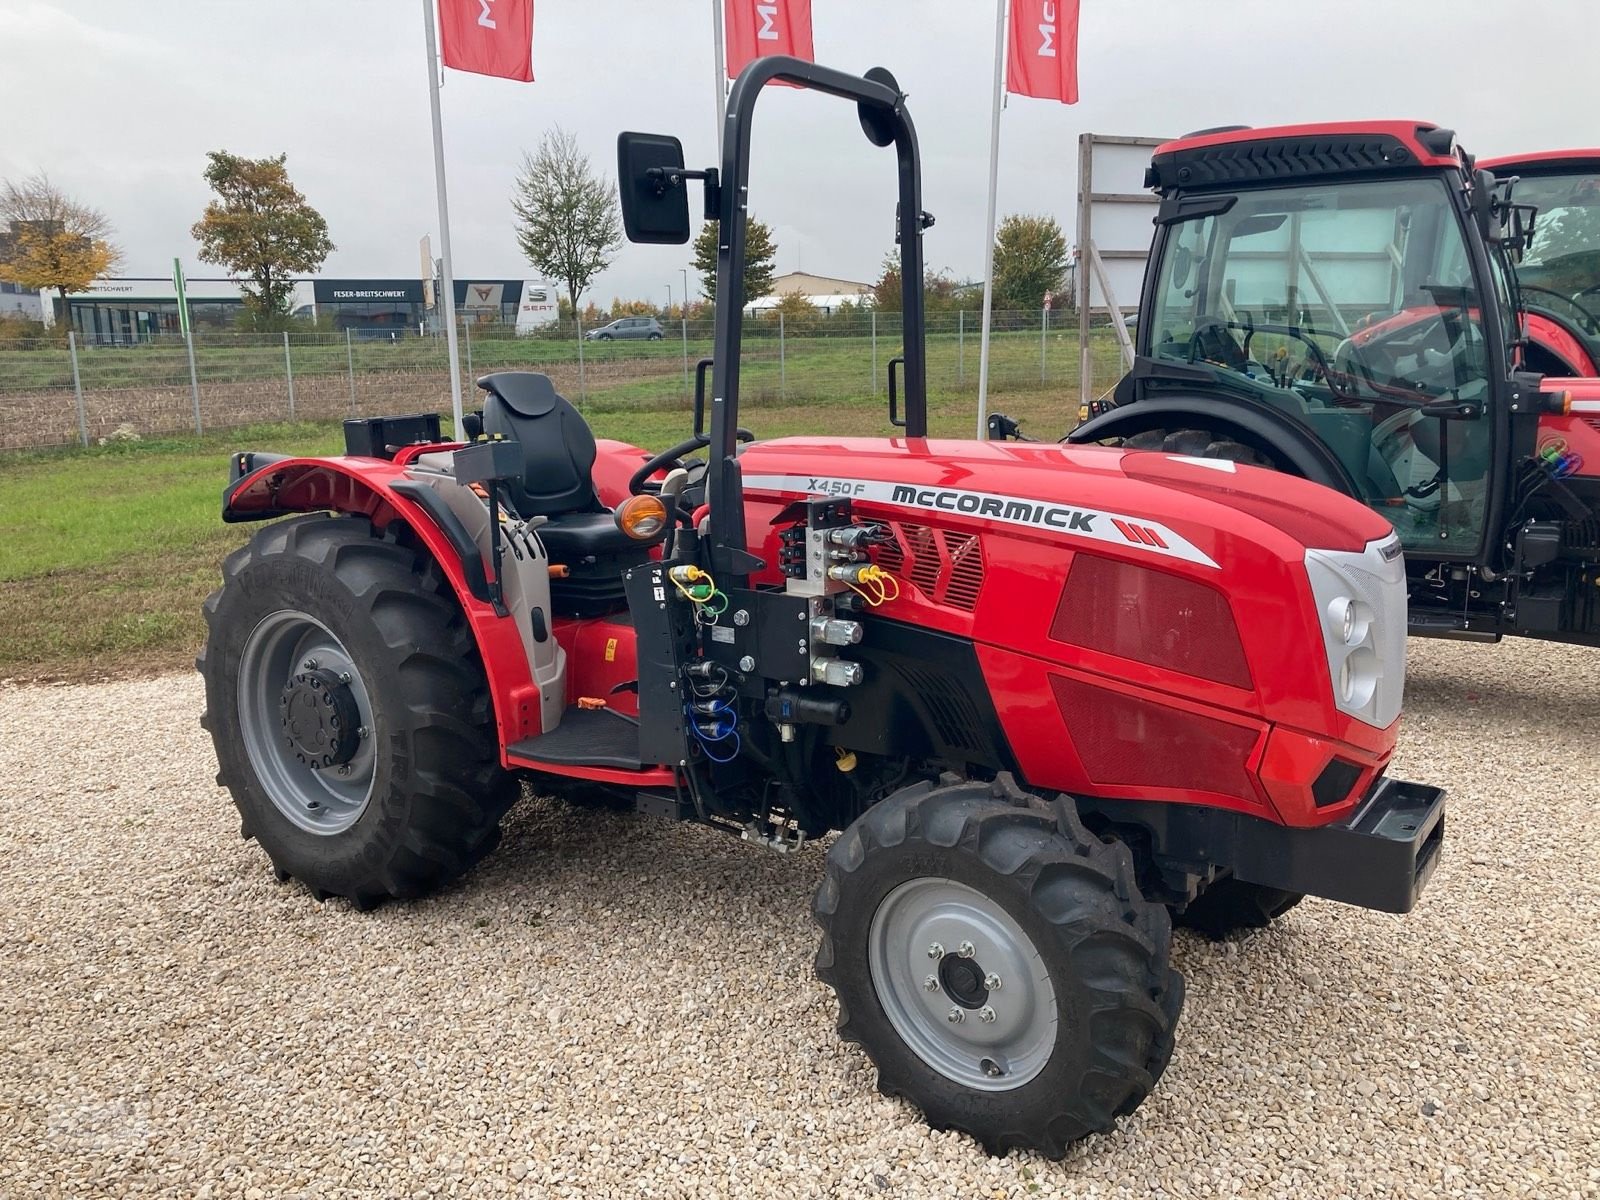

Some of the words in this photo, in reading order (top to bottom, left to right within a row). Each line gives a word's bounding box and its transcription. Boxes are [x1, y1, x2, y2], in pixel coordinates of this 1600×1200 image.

[333, 290, 406, 298] FESER-BREITSCHWERT
[807, 478, 852, 495] X4.50
[853, 484, 866, 496] F
